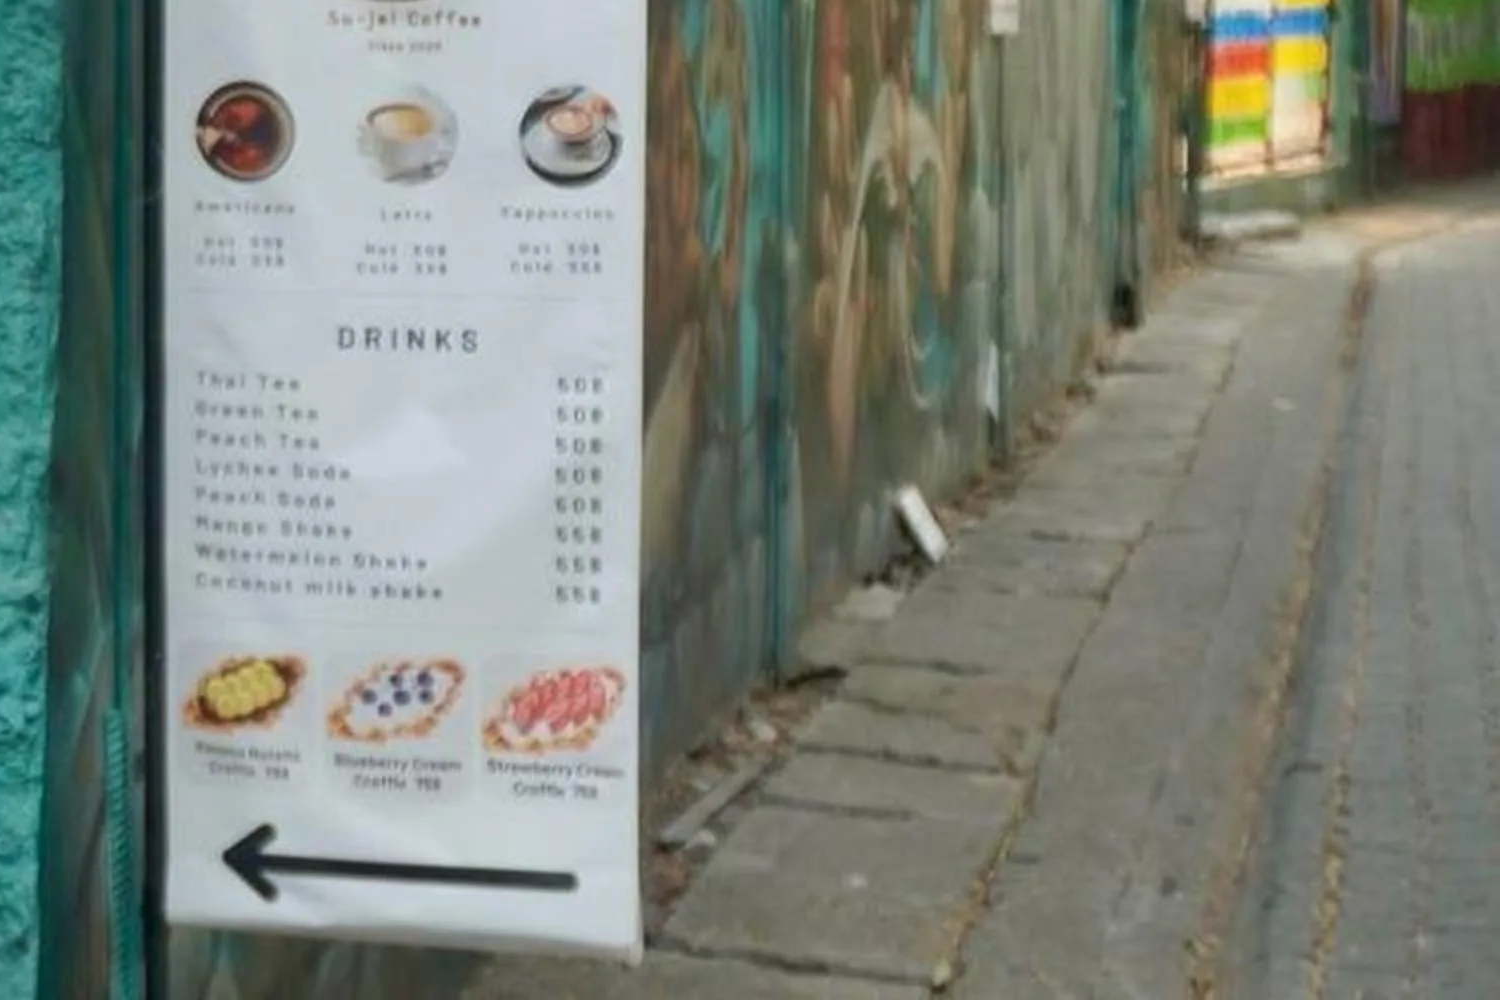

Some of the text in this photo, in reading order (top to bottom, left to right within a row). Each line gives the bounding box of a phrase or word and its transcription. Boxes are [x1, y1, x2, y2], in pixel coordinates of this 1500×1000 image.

[406, 7, 482, 27] Coffee
[337, 325, 479, 354] DRINKS
[196, 370, 246, 390] Thai
[257, 373, 301, 391] Tea
[195, 400, 264, 419] Green
[276, 403, 319, 421] Tea
[195, 429, 267, 448] Peach
[279, 432, 320, 450] Tea
[195, 457, 278, 479] Lychee
[292, 462, 350, 481] Soda
[195, 486, 266, 505] Peach
[278, 490, 336, 508] Soda
[195, 515, 267, 536] Mango
[280, 519, 352, 539] Shake
[195, 544, 341, 566] Watermelon
[353, 552, 428, 570] Shake
[195, 571, 294, 593] Coconut
[333, 753, 409, 772] Blueberry
[486, 759, 571, 778] Strawberry
